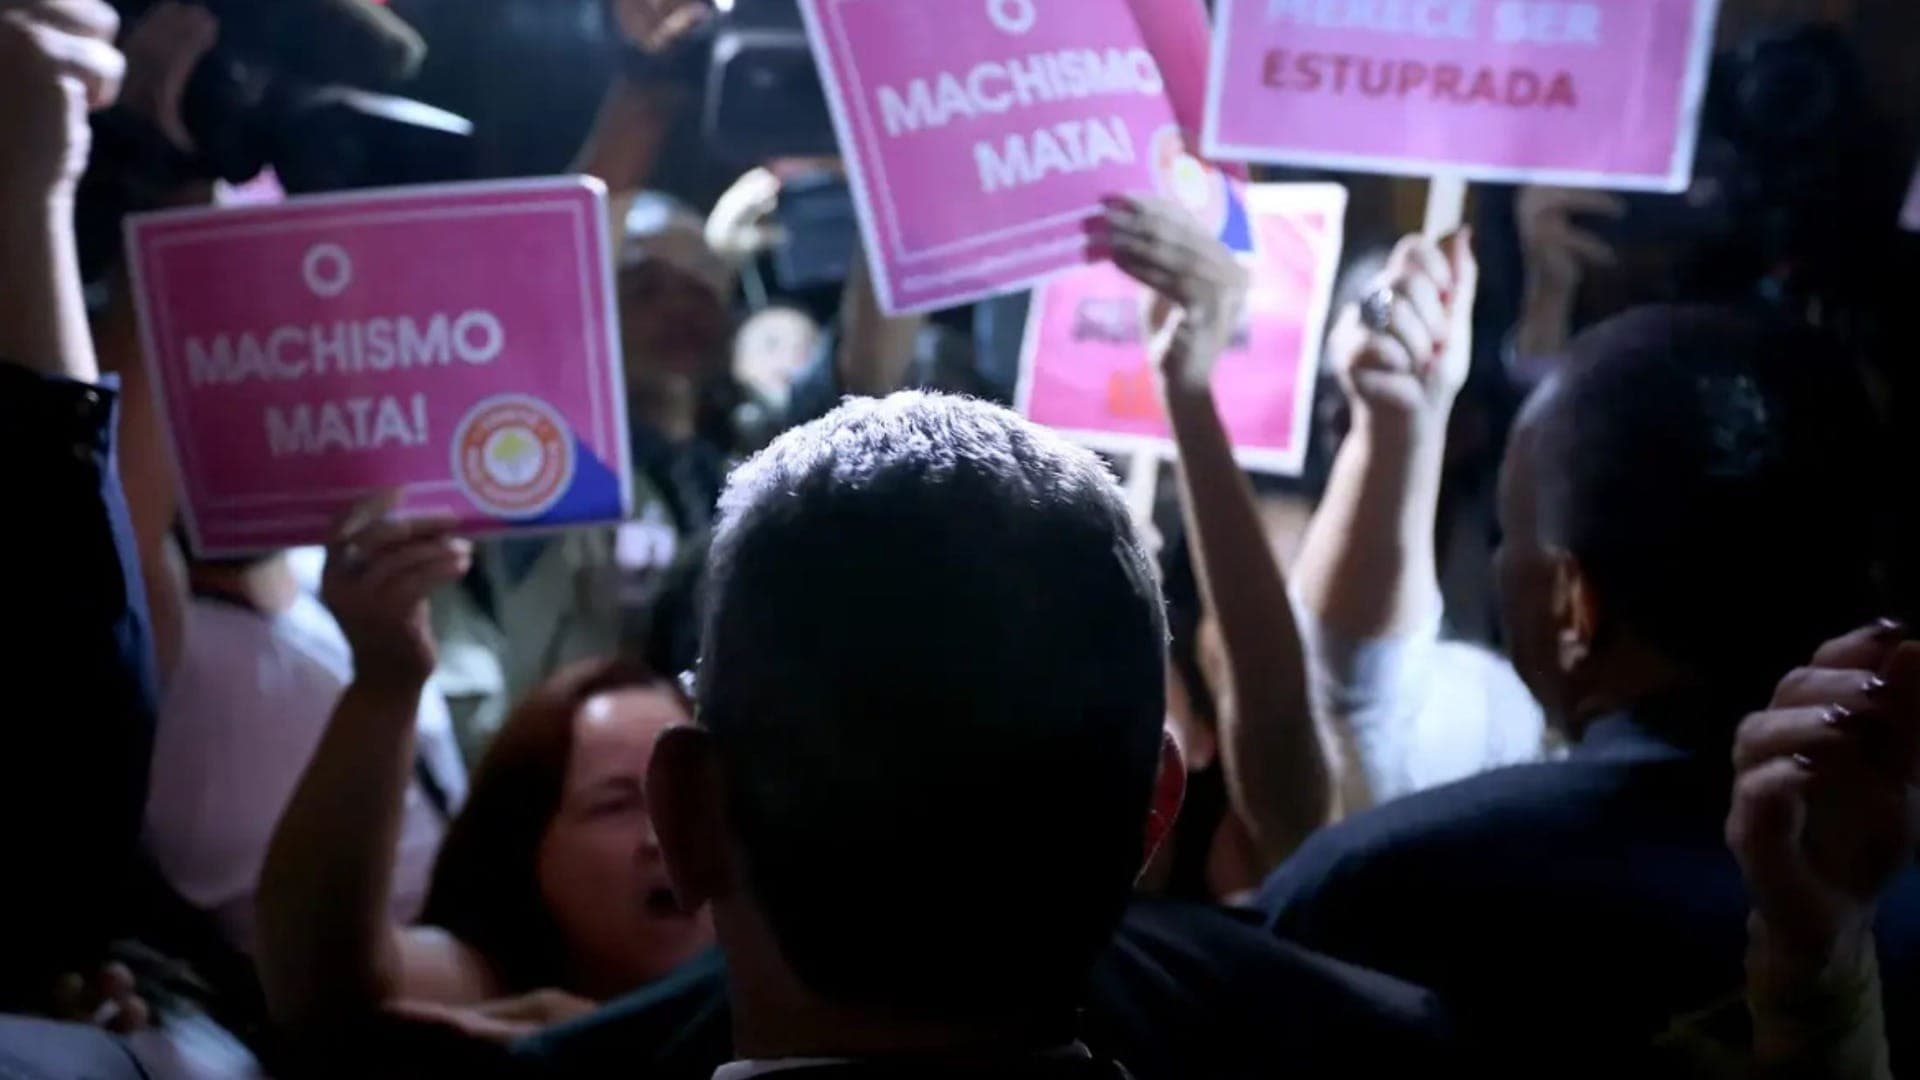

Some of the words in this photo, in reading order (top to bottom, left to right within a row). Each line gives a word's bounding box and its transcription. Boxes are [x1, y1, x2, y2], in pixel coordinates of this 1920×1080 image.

[878, 47, 1164, 138] MACHISMO
[1261, 48, 1577, 108] ESTUPRADA
[973, 116, 1136, 193] MATA!
[303, 243, 352, 297] O
[186, 310, 504, 388] MACHISMO
[264, 393, 429, 456] MATA!
